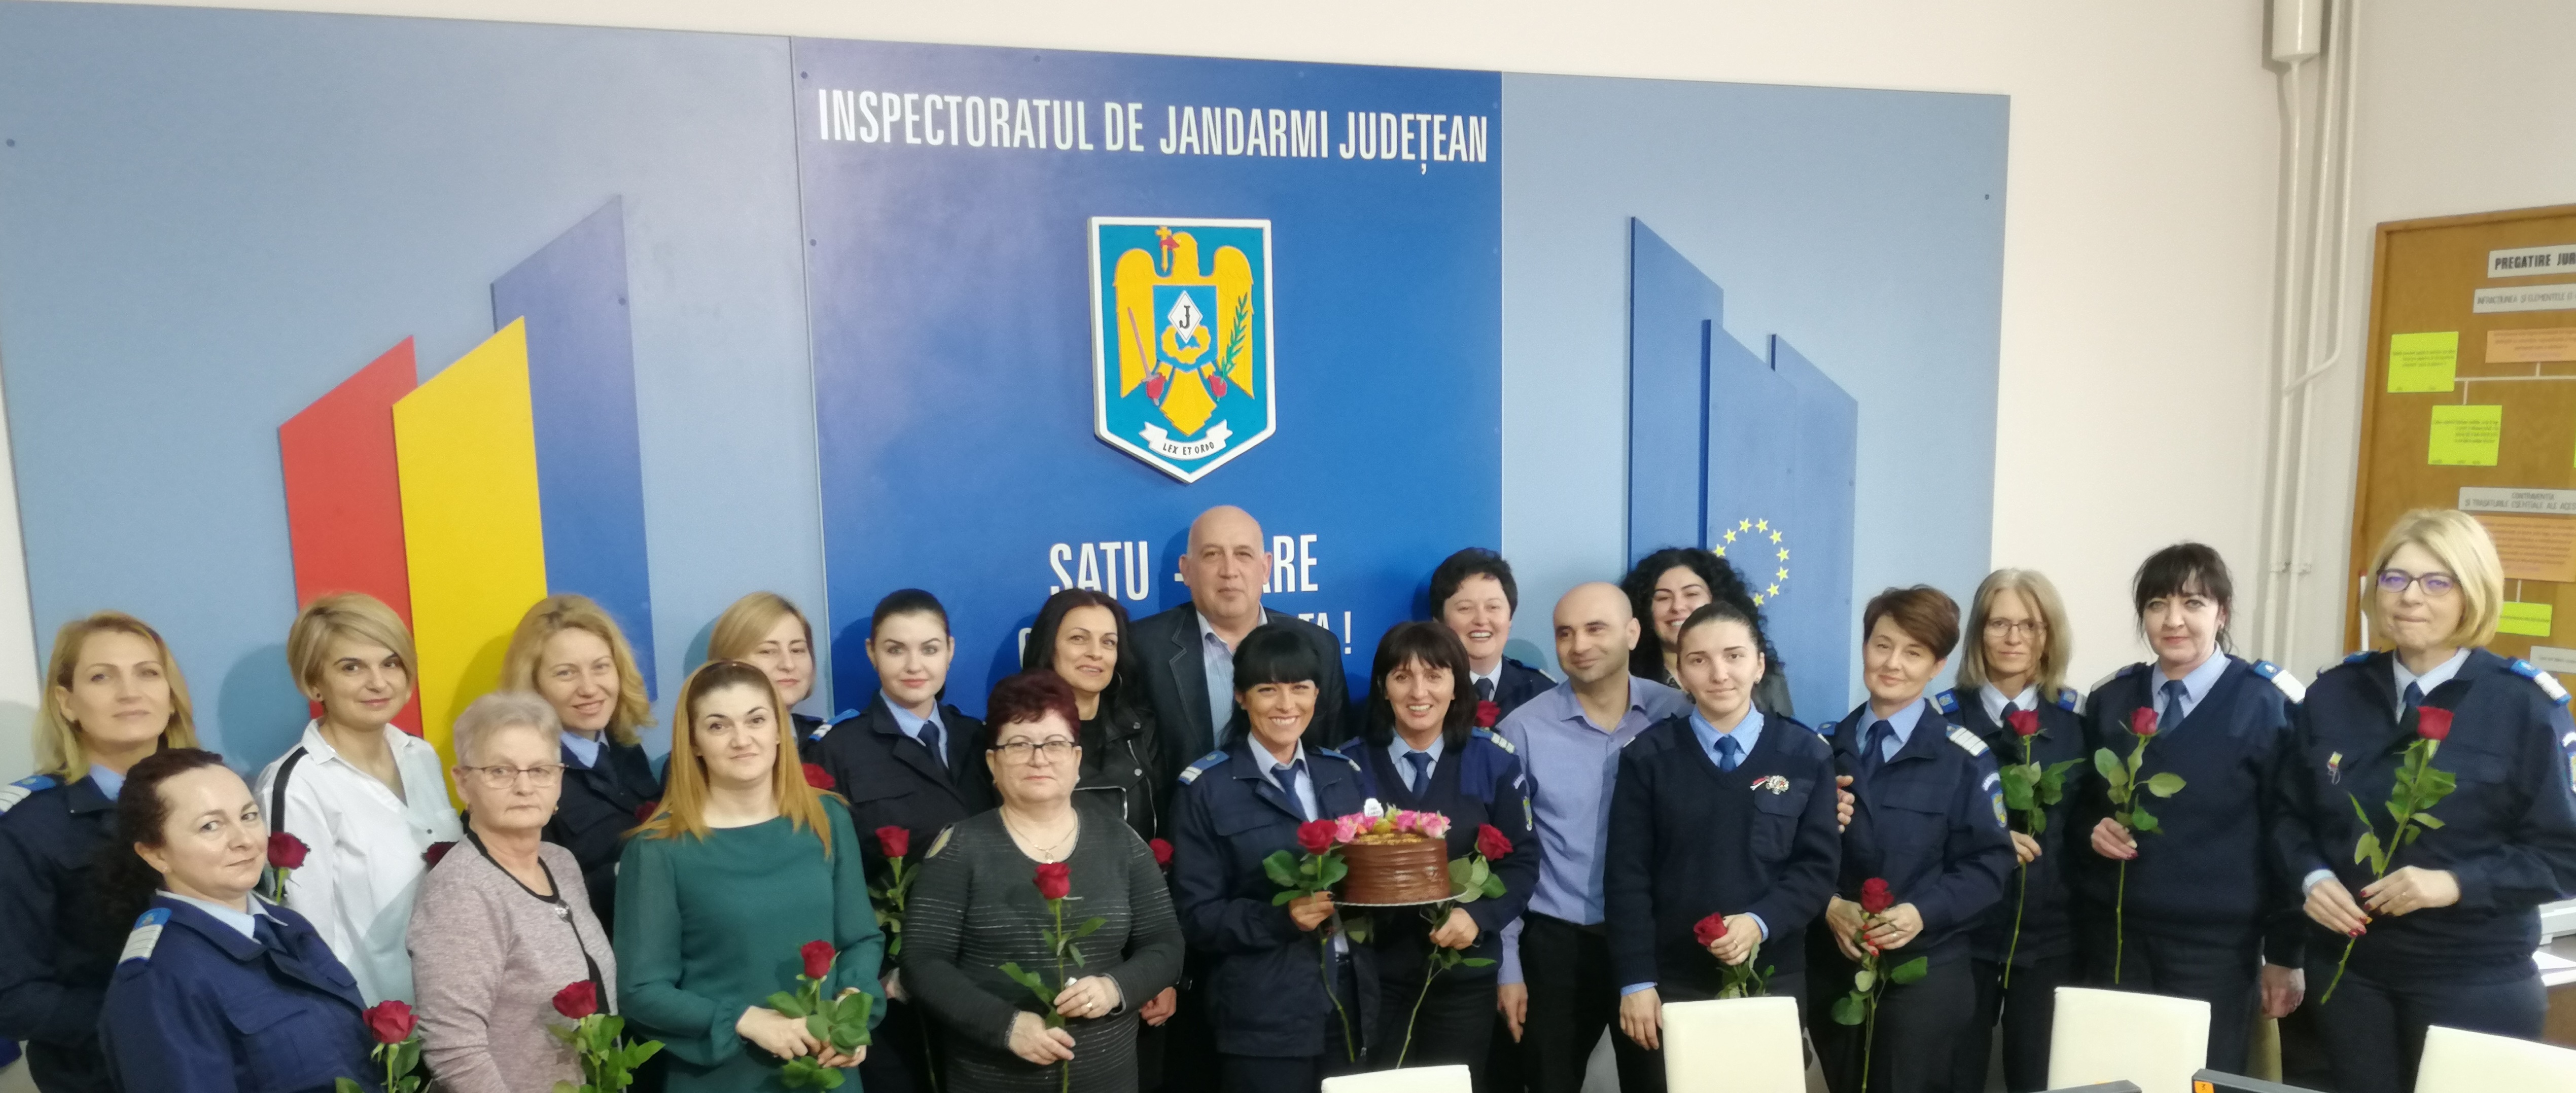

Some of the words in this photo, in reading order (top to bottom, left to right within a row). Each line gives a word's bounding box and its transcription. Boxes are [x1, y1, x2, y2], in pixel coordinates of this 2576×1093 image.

[819, 89, 1094, 151] INSPECTORATUL
[1105, 102, 1145, 152] DE
[1159, 105, 1328, 158] JANDARMI
[1339, 111, 1487, 175] JUDEȚEAN
[1179, 305, 1191, 329] J
[1162, 443, 1179, 455] LEX
[1182, 446, 1192, 456] ET
[1194, 442, 1215, 454] ORDO
[1049, 540, 1149, 601] SATU
